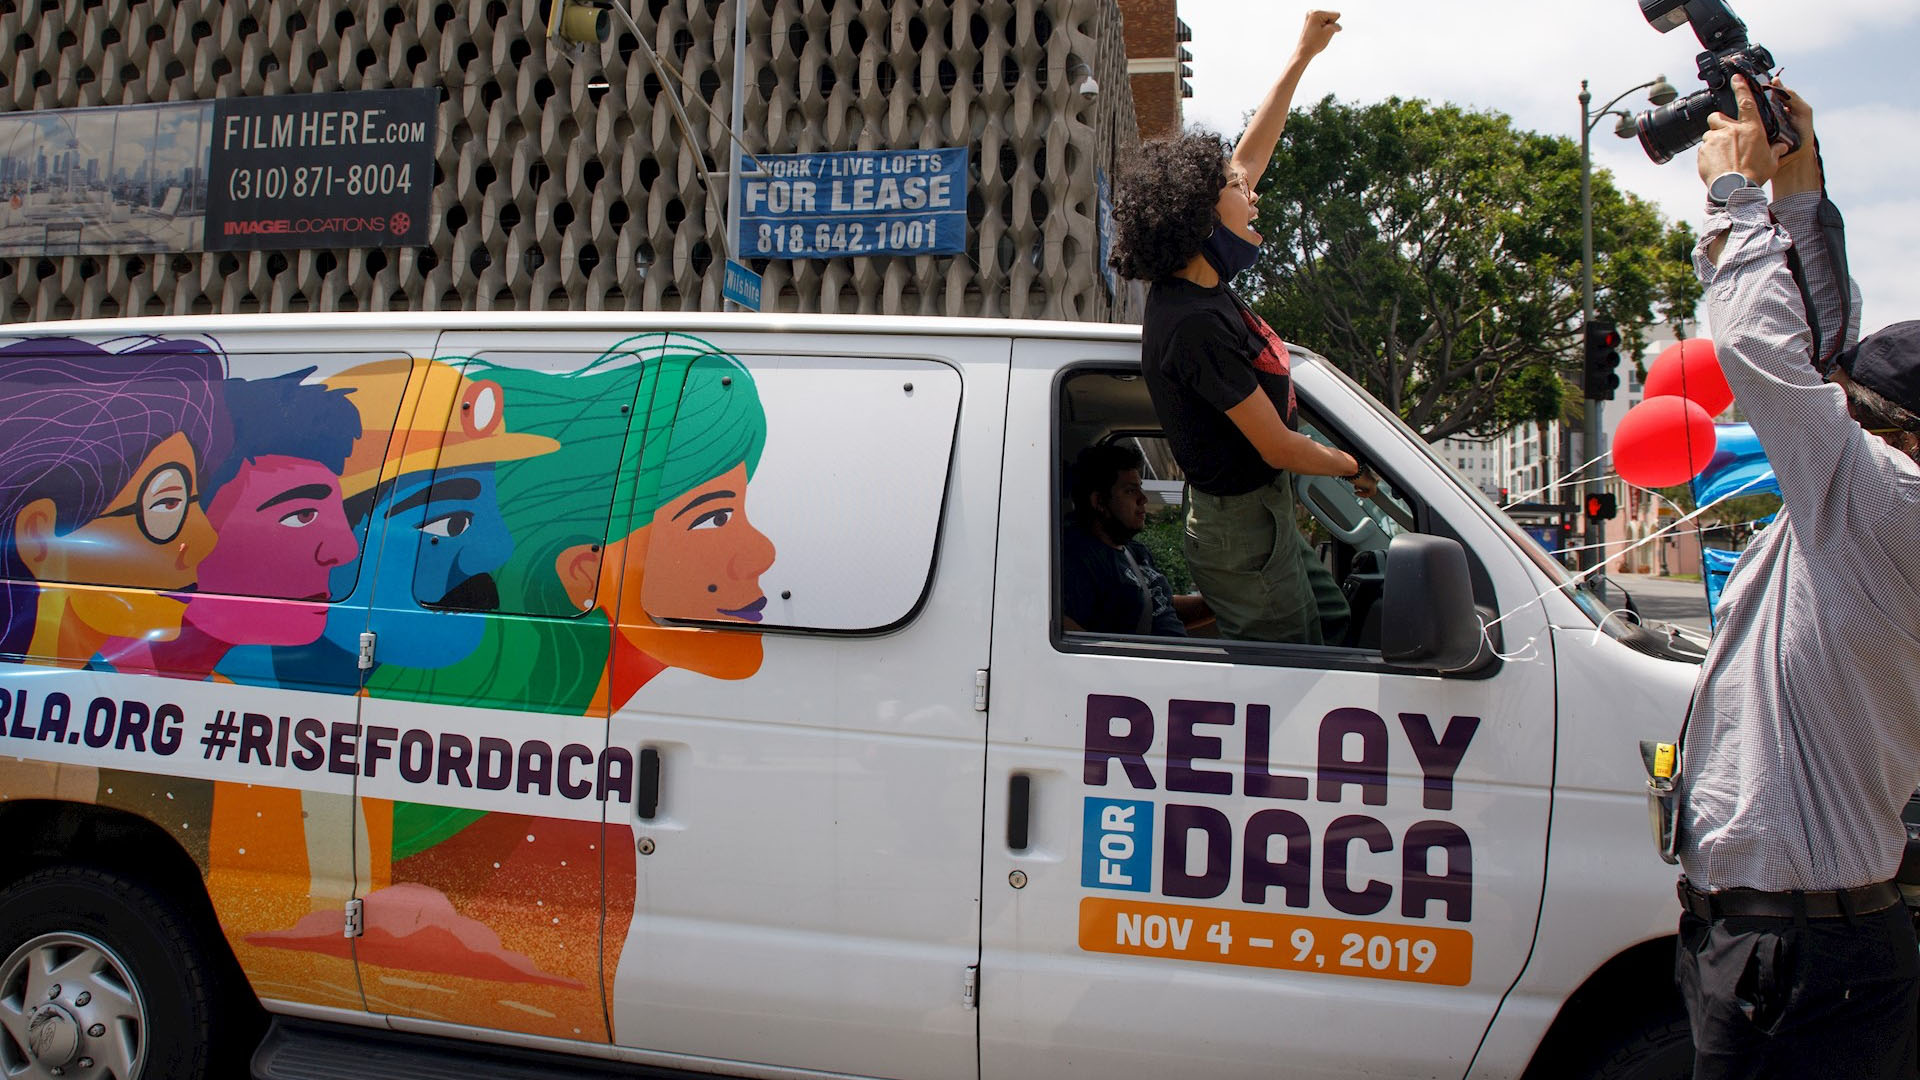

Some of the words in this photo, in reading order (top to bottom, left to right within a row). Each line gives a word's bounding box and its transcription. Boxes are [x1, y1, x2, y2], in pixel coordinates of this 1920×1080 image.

[229, 167, 288, 201] (310)
[294, 163, 412, 197] 871-8004
[756, 158, 812, 178] WORK
[818, 159, 826, 179] /
[832, 157, 873, 177] LIVE
[880, 154, 942, 174] LOFTS
[746, 181, 816, 213] FOR
[831, 174, 950, 212] LEASE
[757, 219, 936, 253] 818.642.1001
[727, 269, 760, 303] Wilshire
[200, 708, 633, 804] #RISEFORDACA
[1083, 693, 1481, 811] RELAY
[1100, 805, 1136, 886] FOR
[1162, 803, 1473, 922] DACA
[1116, 912, 1193, 951] NOV
[1206, 921, 1233, 955] 4
[1290, 928, 1325, 969] 9,
[1340, 932, 1437, 974] 2019
